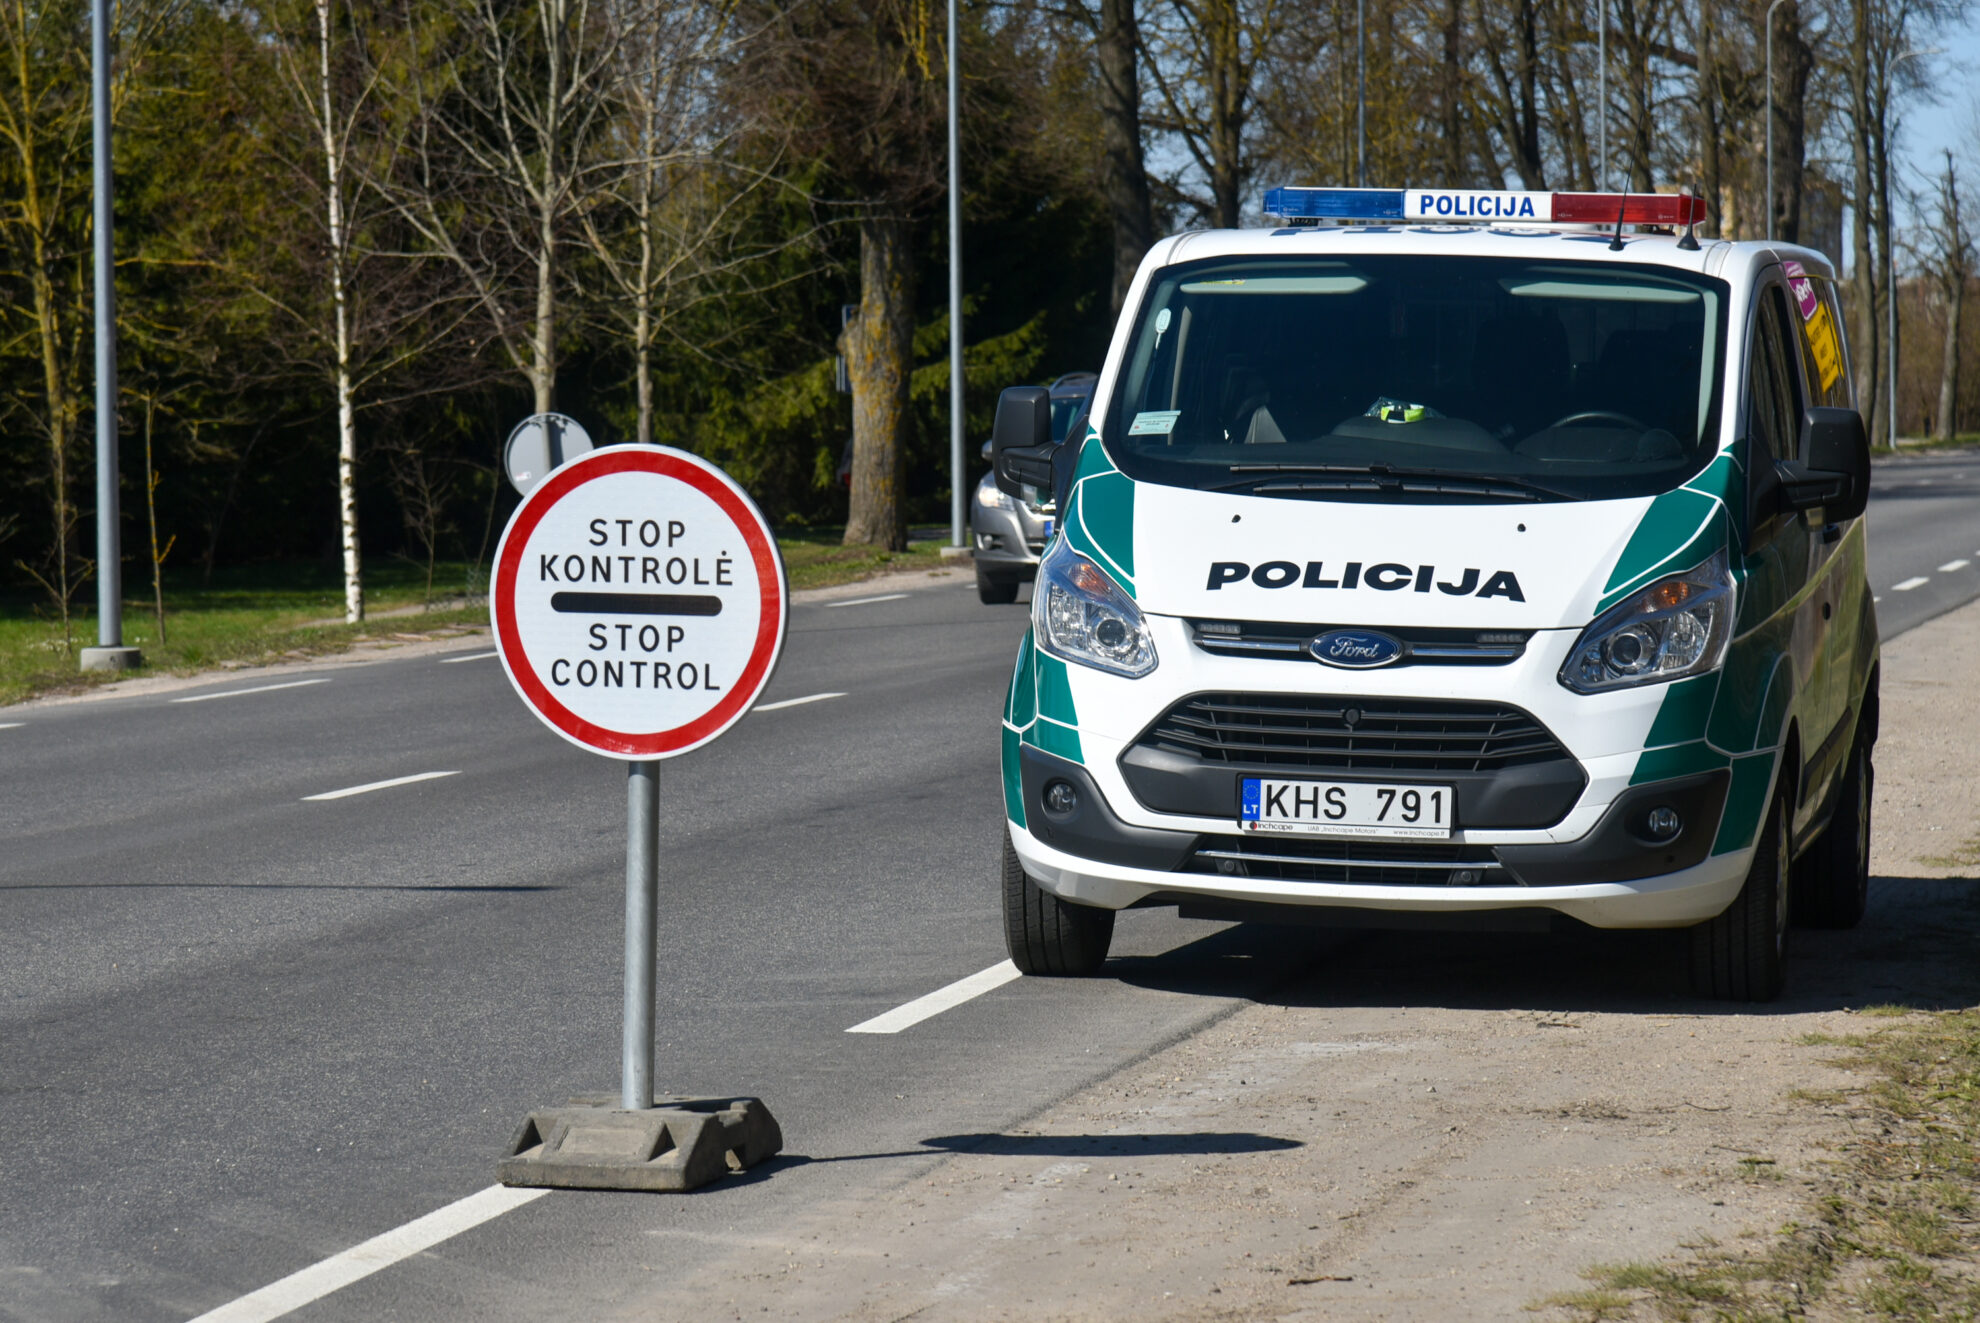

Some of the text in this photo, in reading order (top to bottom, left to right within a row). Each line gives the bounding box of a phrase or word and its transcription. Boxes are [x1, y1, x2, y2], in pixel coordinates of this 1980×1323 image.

[1420, 195, 1535, 217] POLICIJA
[589, 518, 686, 548] STOP
[540, 550, 733, 586] KONTROLĖ
[1206, 560, 1526, 603] POLICIJA
[588, 622, 685, 653] STOP
[1329, 637, 1379, 659] Ford
[551, 658, 720, 691] CONTROL
[1243, 804, 1259, 814] LT
[1265, 784, 1442, 824] KHS 791
